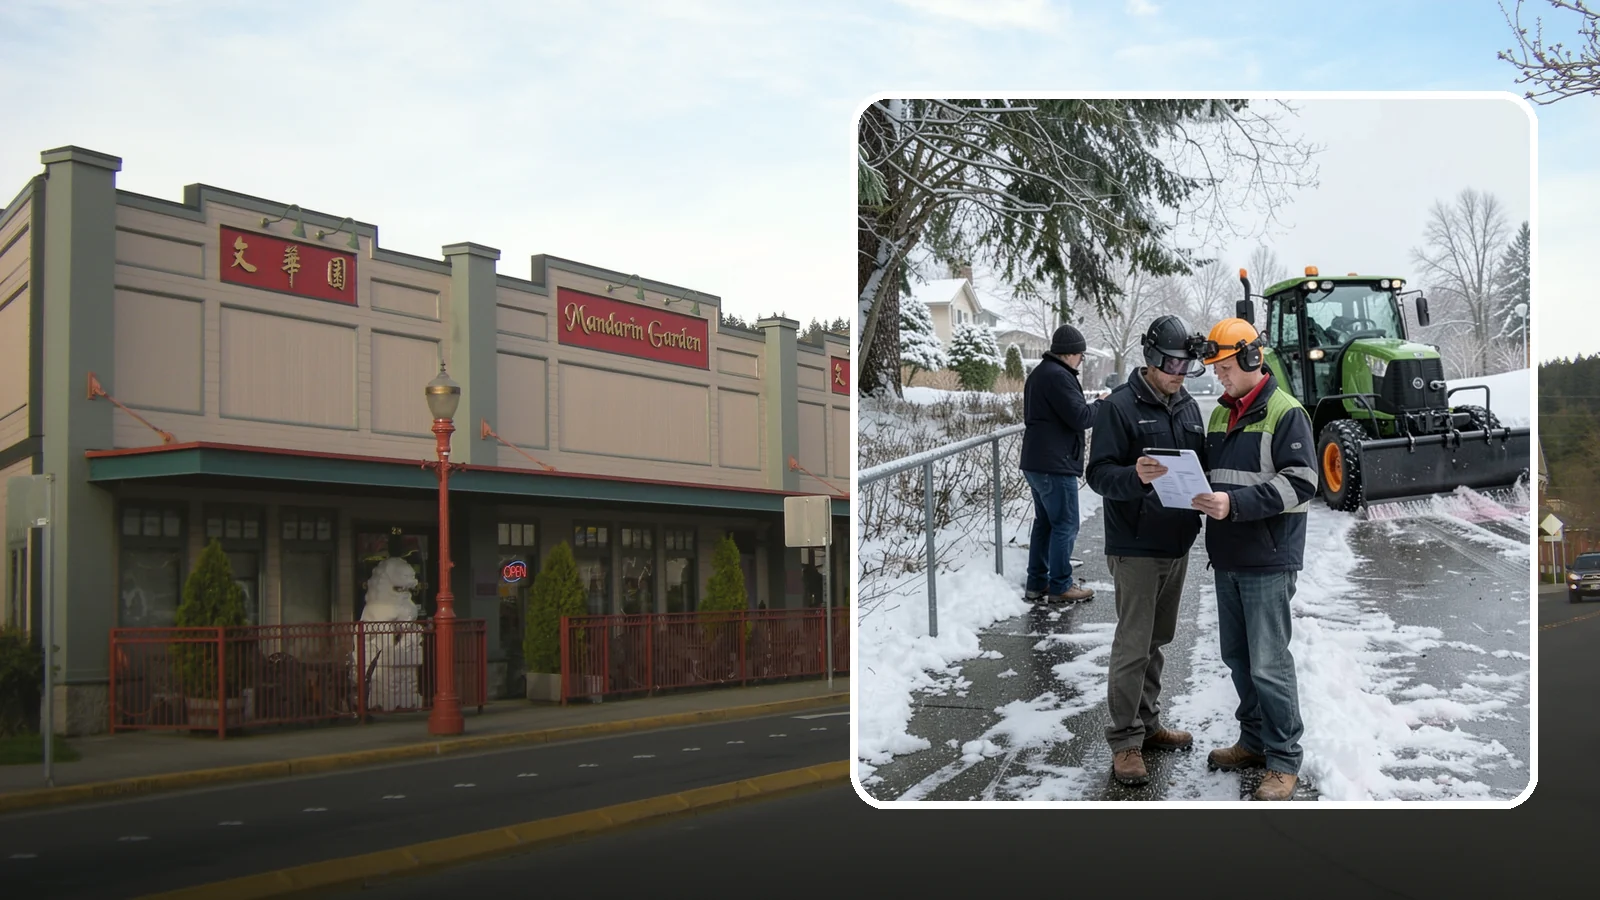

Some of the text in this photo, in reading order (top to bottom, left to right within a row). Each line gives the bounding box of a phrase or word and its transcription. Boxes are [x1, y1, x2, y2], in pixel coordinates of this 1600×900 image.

[231, 236, 346, 290] 文華園
[564, 302, 701, 352] Mandarin Garden
[503, 565, 527, 578] OPEN
